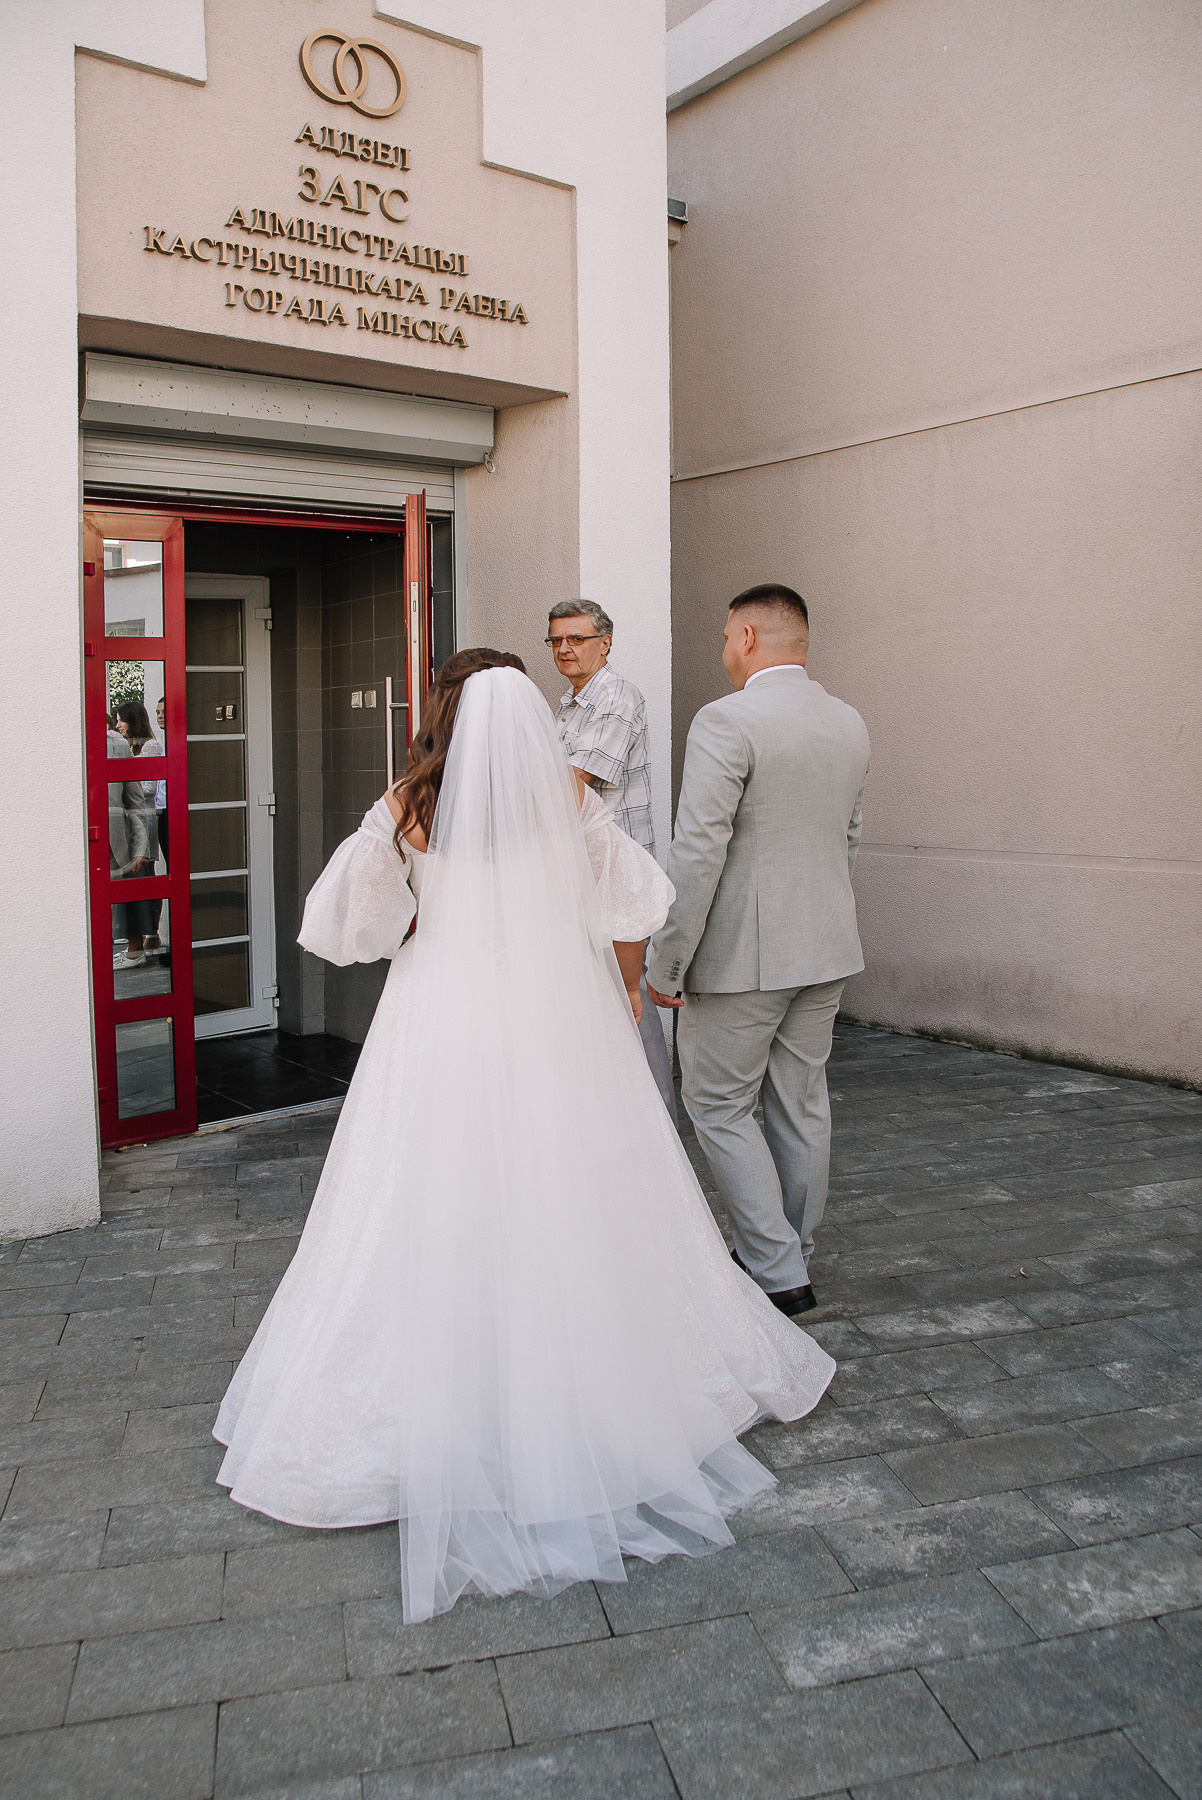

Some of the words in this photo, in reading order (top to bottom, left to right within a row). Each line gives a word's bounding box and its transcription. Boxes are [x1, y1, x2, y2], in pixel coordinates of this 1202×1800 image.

[295, 121, 411, 171] АДДЗЕЛ
[298, 165, 410, 223] ЗАГС
[143, 225, 430, 305] КАСТРЫЧНІЦКАГА
[225, 204, 469, 276] АДМІНІСТРАЦЫІ
[225, 282, 349, 327] ГОРАДА
[357, 307, 469, 348] МІНСКА
